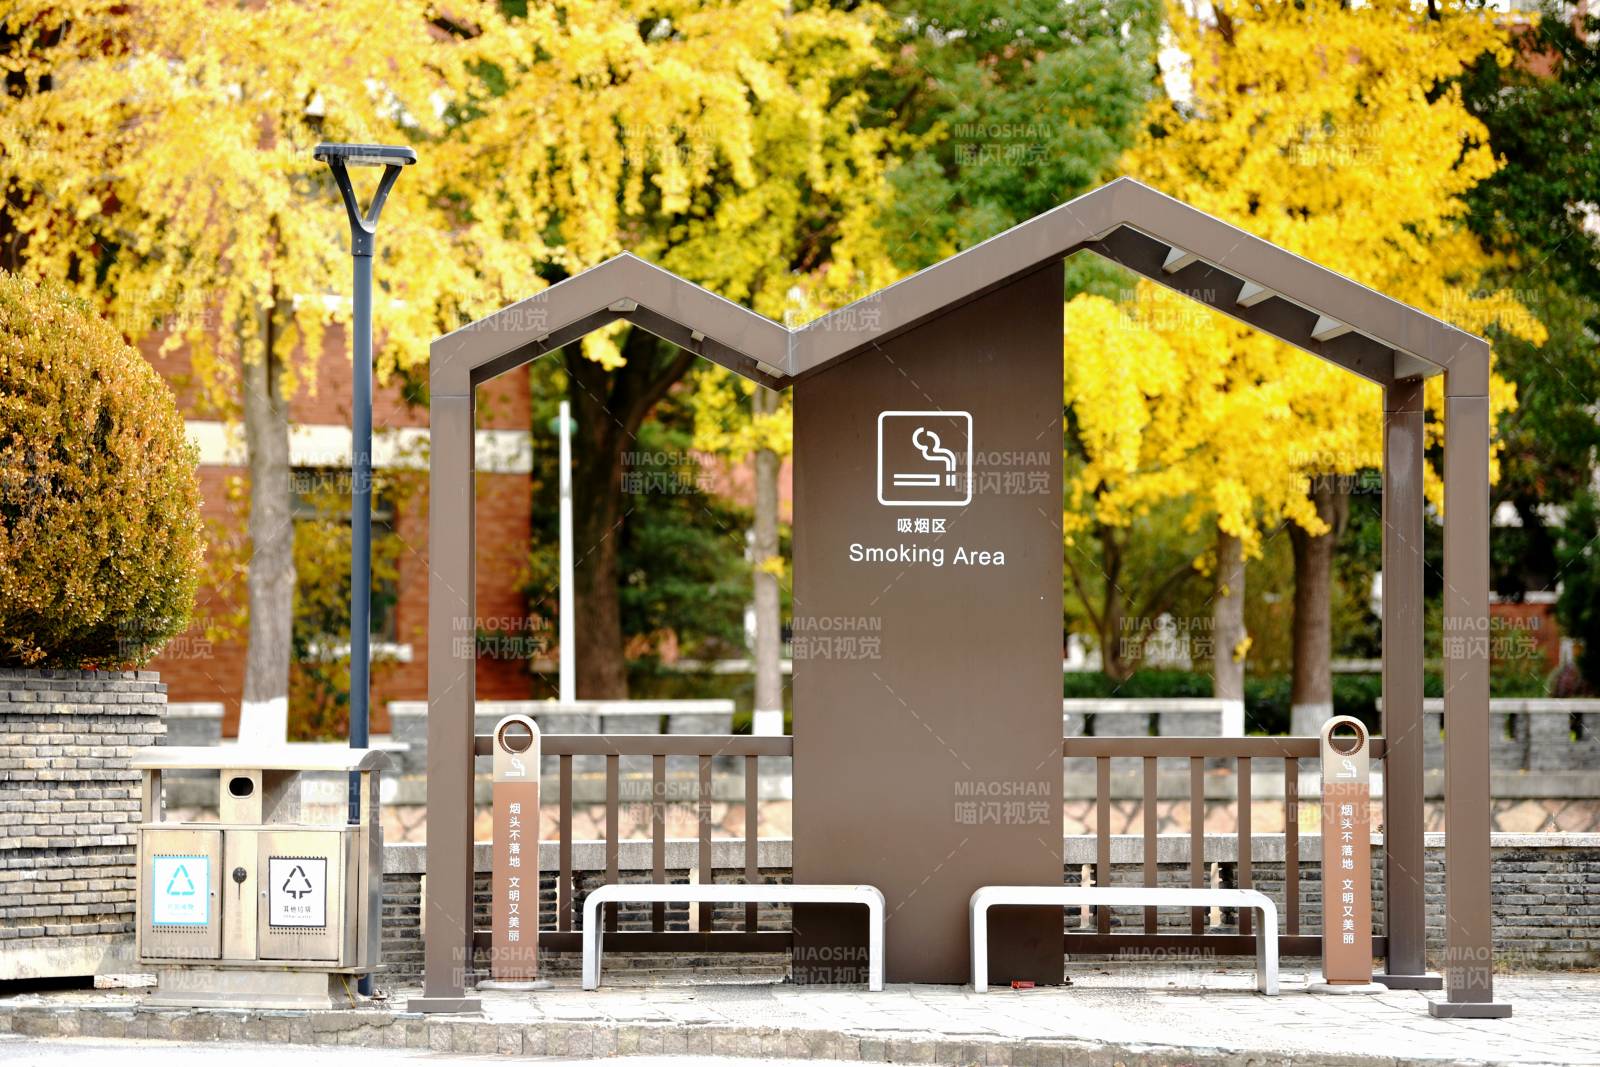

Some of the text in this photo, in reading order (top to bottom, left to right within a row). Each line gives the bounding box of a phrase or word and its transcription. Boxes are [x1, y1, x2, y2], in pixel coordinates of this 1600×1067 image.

[849, 543, 1005, 567] Smoking Area
[897, 518, 946, 534] 吸烟区
[508, 802, 521, 942] 烟头不落地 文明又美丽
[1340, 804, 1355, 944] 烟头不落地 文明又美丽
